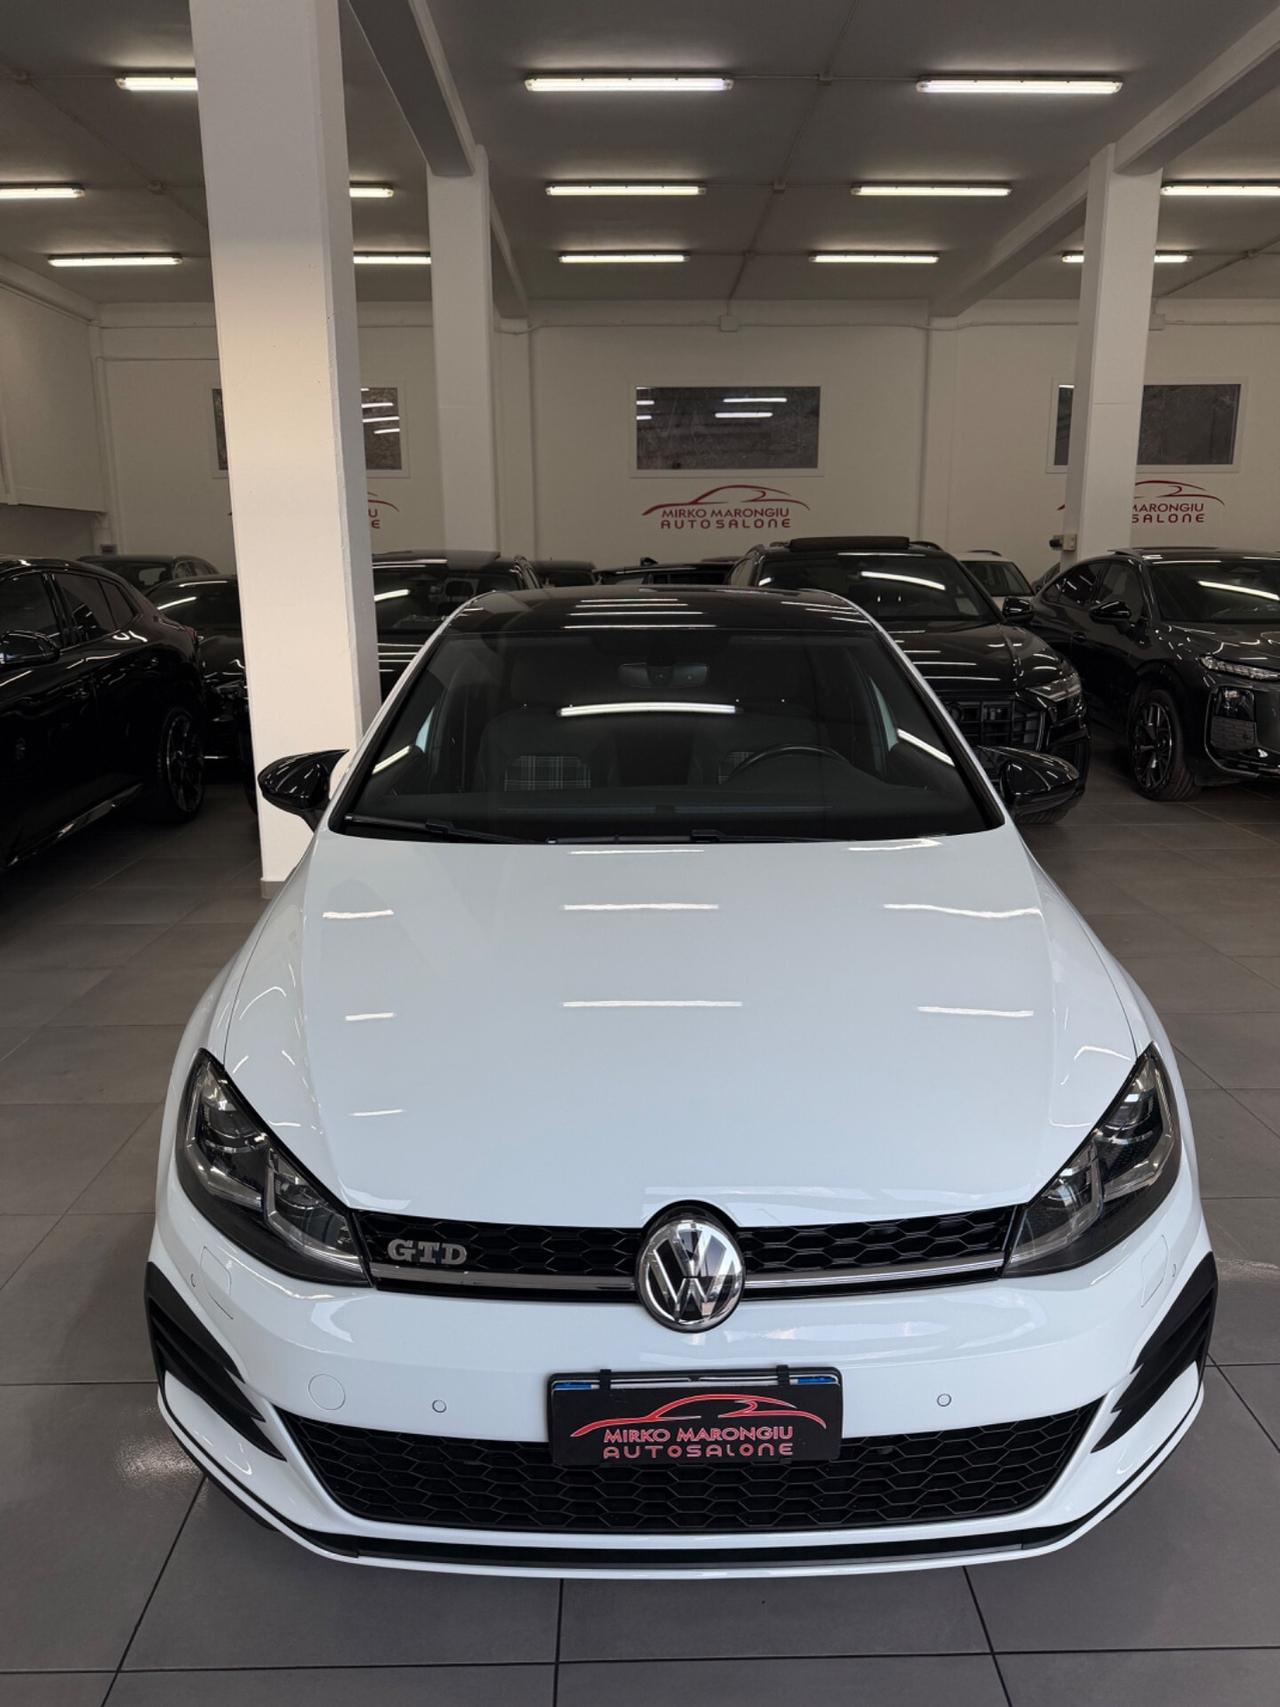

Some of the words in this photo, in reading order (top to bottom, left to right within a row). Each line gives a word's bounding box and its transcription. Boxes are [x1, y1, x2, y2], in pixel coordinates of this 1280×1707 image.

[662, 508, 706, 518] MIRKO
[711, 508, 789, 518] MARONGIU
[1132, 513, 1204, 523] SALONE
[661, 518, 791, 529] AUTOSALONE
[387, 1238, 467, 1265] GTD
[603, 1429, 671, 1443] MIRKO
[676, 1426, 793, 1442] MARONGIU
[603, 1444, 793, 1459] AUTOSALONE
